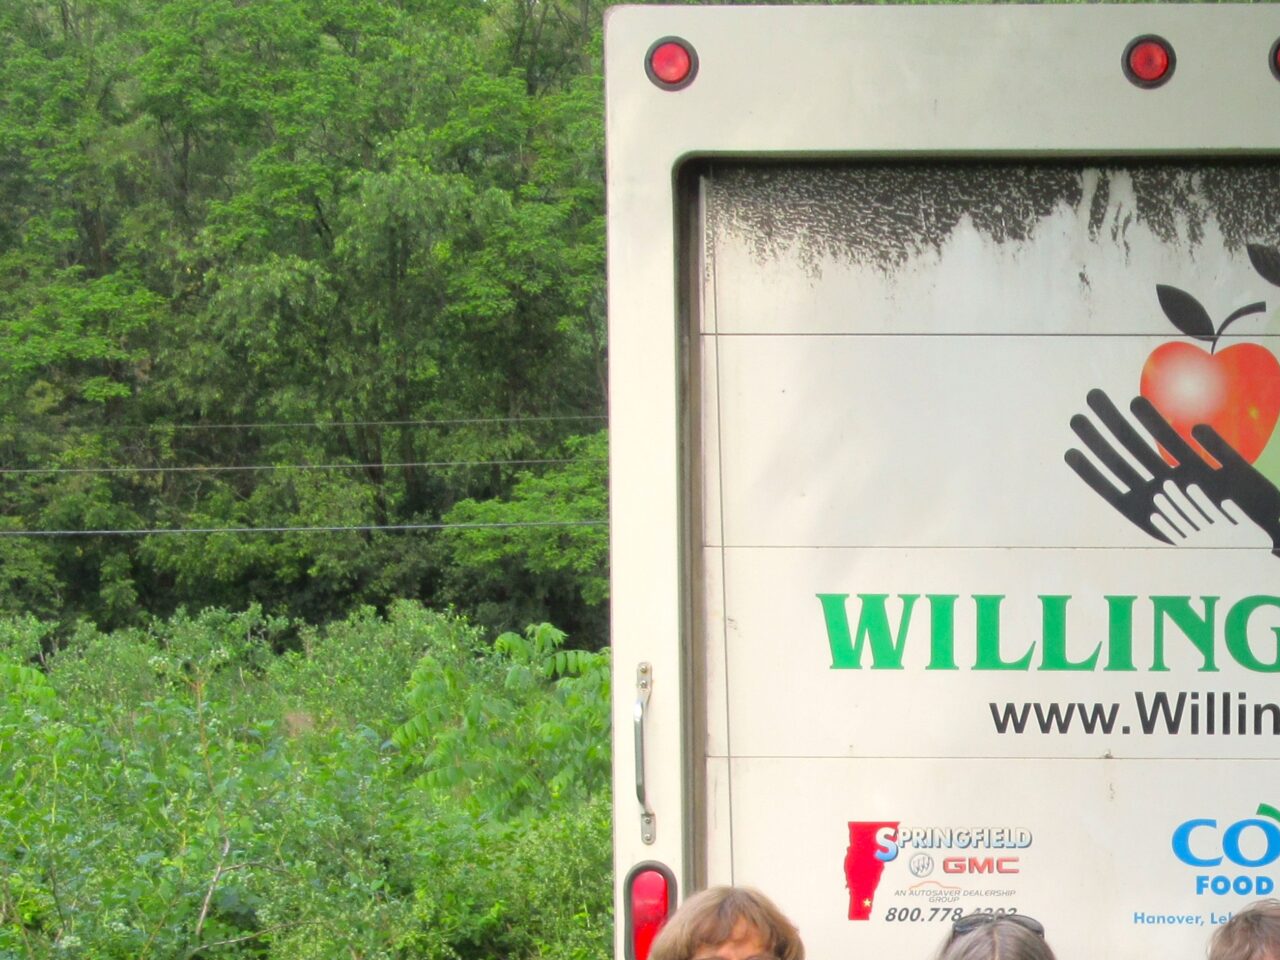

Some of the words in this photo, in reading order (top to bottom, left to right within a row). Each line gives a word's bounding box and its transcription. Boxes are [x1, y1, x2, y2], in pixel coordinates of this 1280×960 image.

[875, 827, 1033, 862] SPRINGFIELD
[942, 857, 1020, 874] GMC
[1196, 876, 1274, 896] FOOD
[1133, 912, 1204, 926] Hanover,
